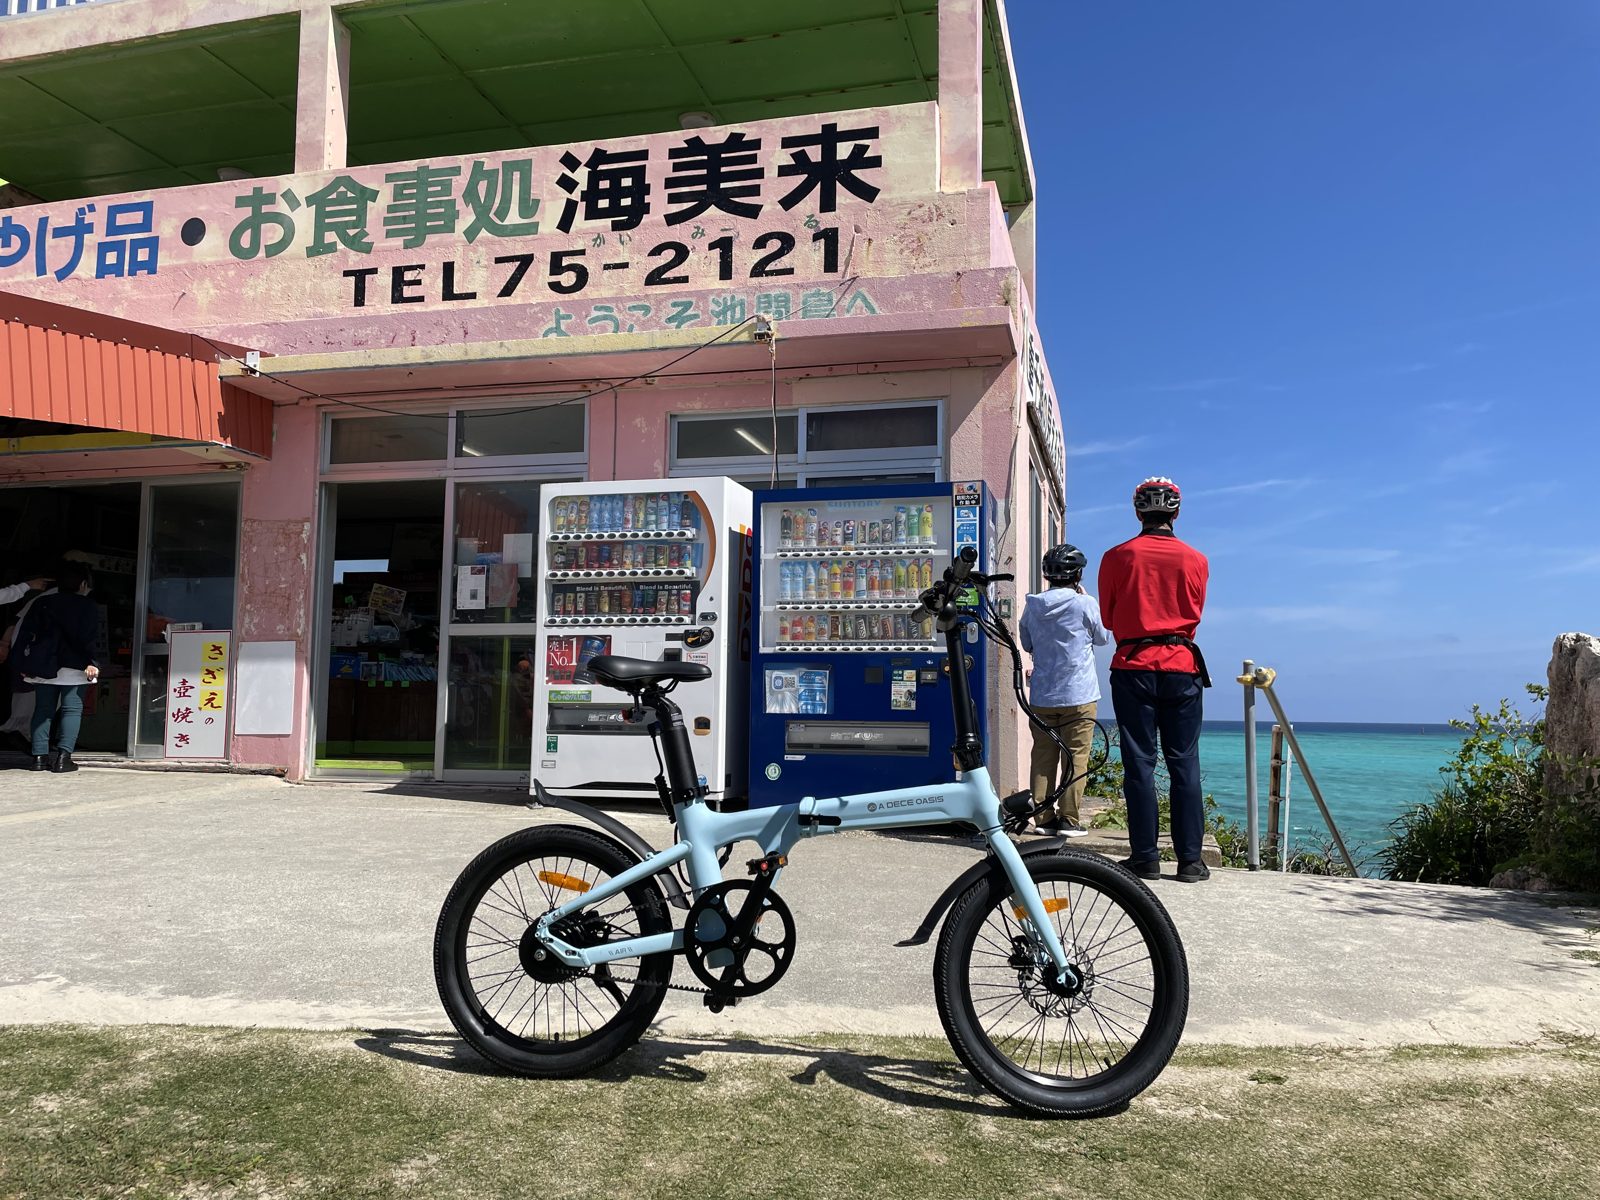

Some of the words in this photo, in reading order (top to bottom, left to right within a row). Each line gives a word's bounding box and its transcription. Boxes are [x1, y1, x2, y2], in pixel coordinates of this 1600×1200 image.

[555, 122, 882, 234] 海美来
[343, 261, 477, 307] TEL
[494, 227, 839, 298] 75-2121
[886, 799, 914, 808] DECE
[915, 795, 944, 804] OASIS
